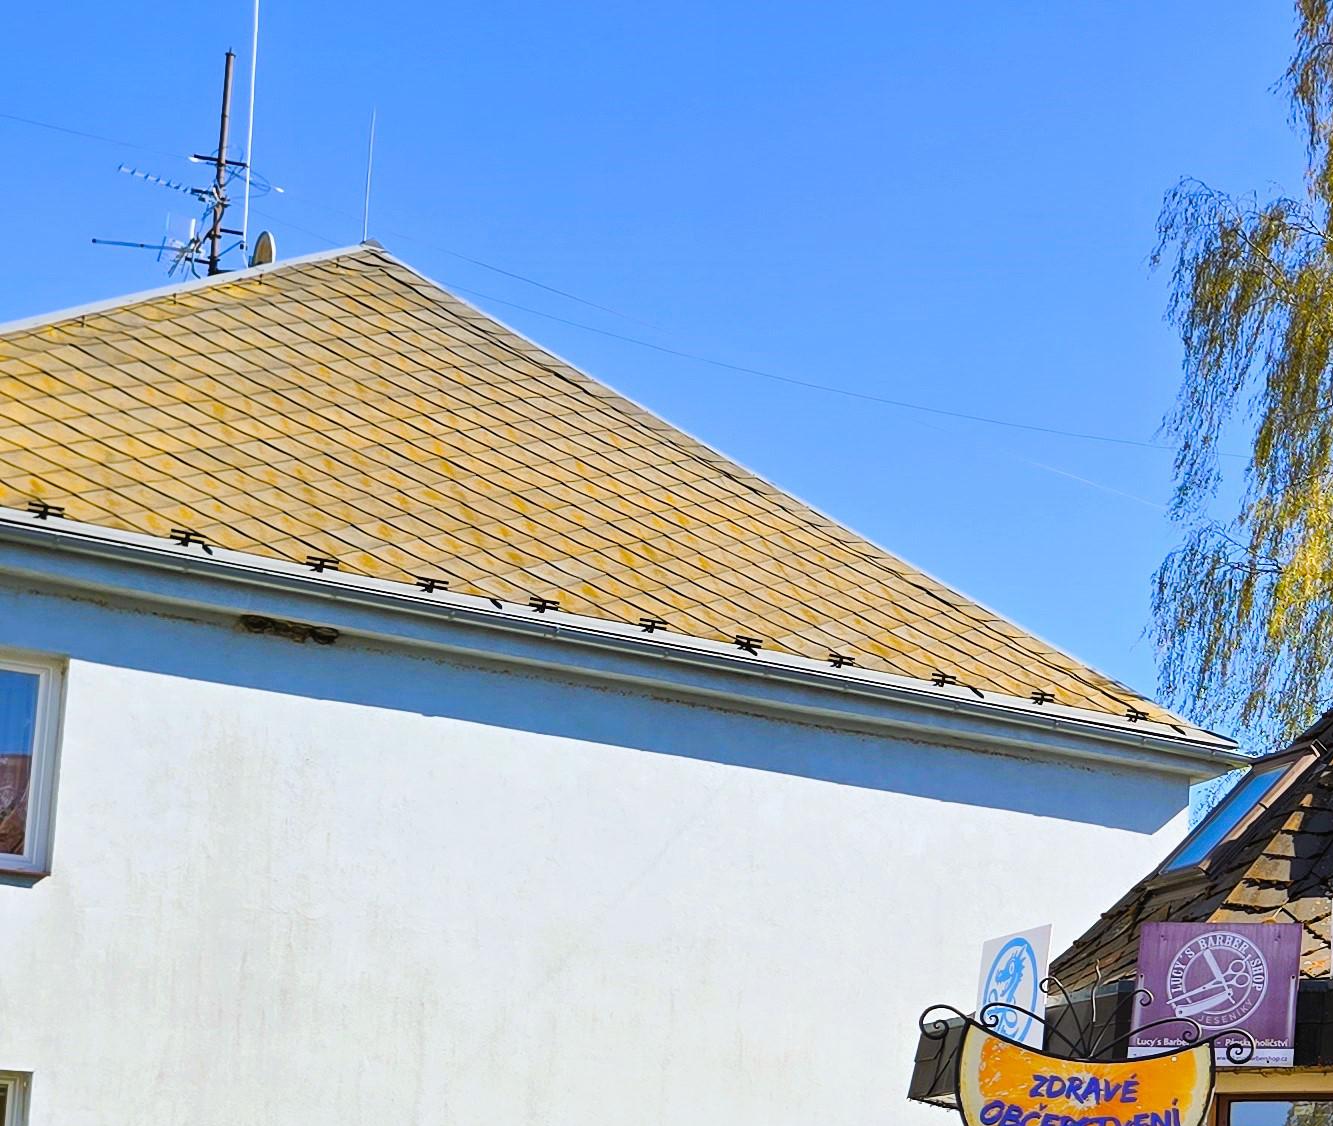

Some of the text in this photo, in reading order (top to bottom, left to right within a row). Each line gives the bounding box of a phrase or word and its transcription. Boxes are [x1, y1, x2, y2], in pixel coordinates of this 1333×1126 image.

[1198, 934, 1249, 955] BARBER
[1251, 959, 1265, 992] SHOP
[1163, 1038, 1189, 1046] Barbe
[1029, 1073, 1140, 1104] ZDRAVÉ
